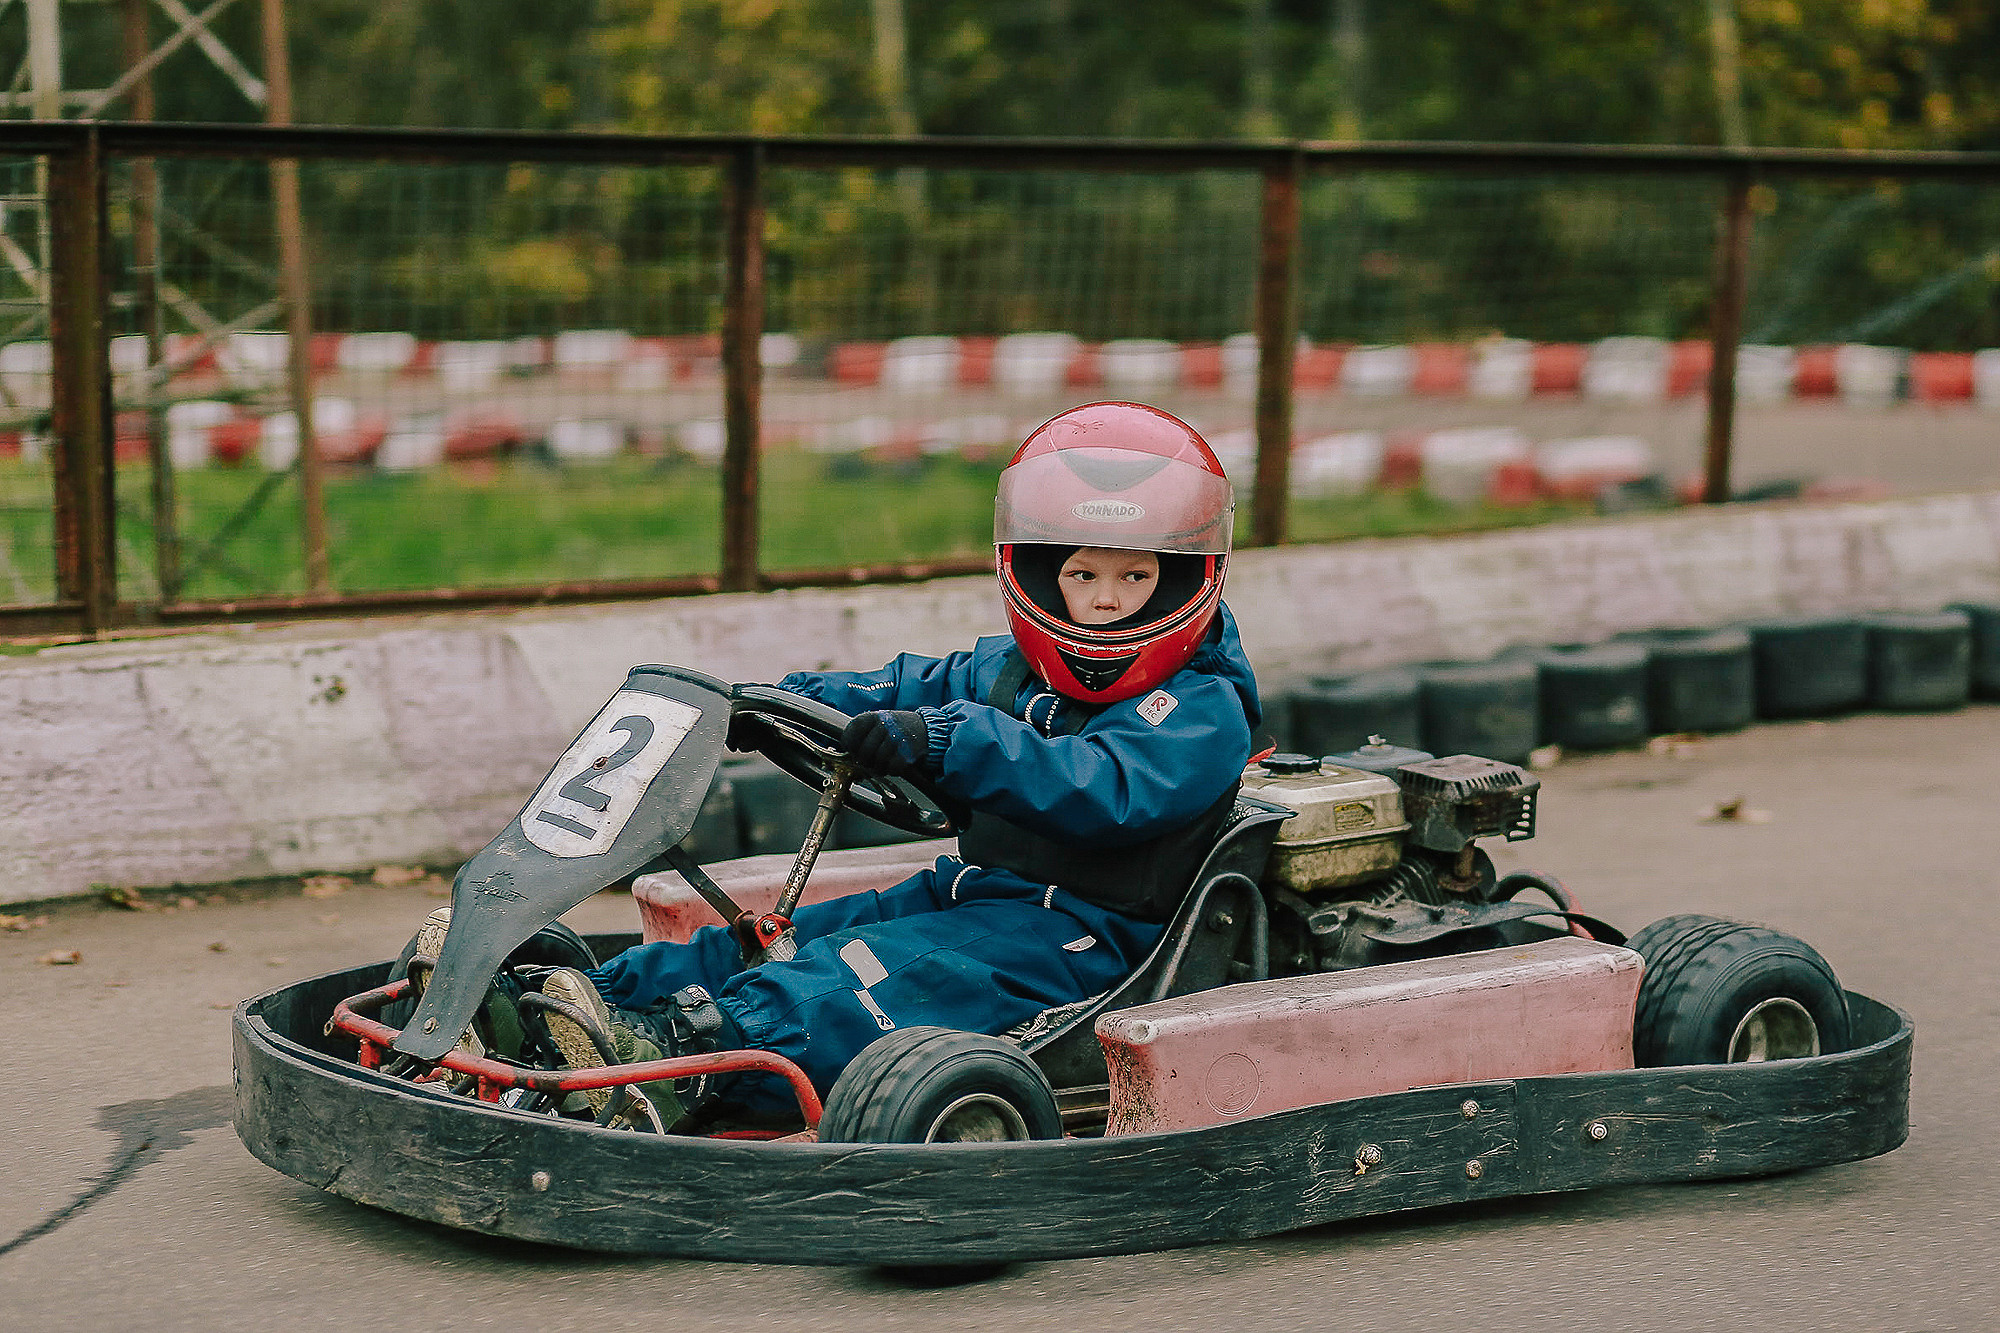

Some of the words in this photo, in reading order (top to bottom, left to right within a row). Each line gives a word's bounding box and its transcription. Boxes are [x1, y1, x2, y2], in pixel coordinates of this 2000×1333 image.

[1081, 504, 1136, 516] TORNADO
[1144, 707, 1158, 719] TEC
[558, 715, 655, 812] 2
